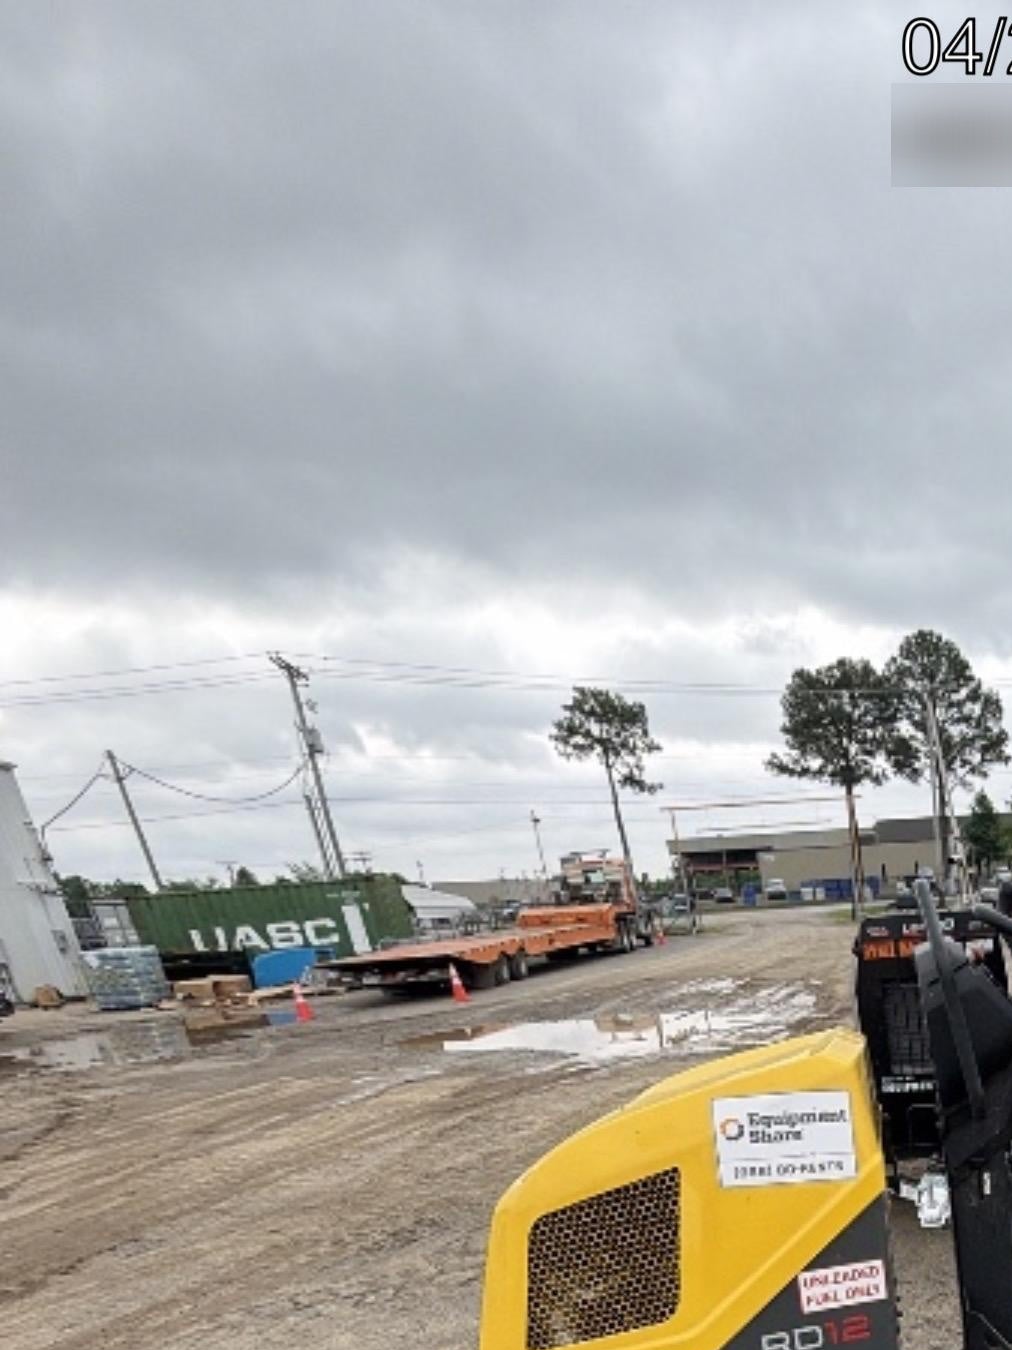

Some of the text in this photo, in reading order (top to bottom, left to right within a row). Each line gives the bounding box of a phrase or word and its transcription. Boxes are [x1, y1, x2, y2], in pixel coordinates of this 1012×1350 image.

[189, 916, 340, 952] UASC
[747, 1109, 847, 1129] Equipment
[749, 1129, 803, 1144] Share
[803, 1265, 880, 1289] UNLEADED
[806, 1284, 880, 1307] FUEL ONLY
